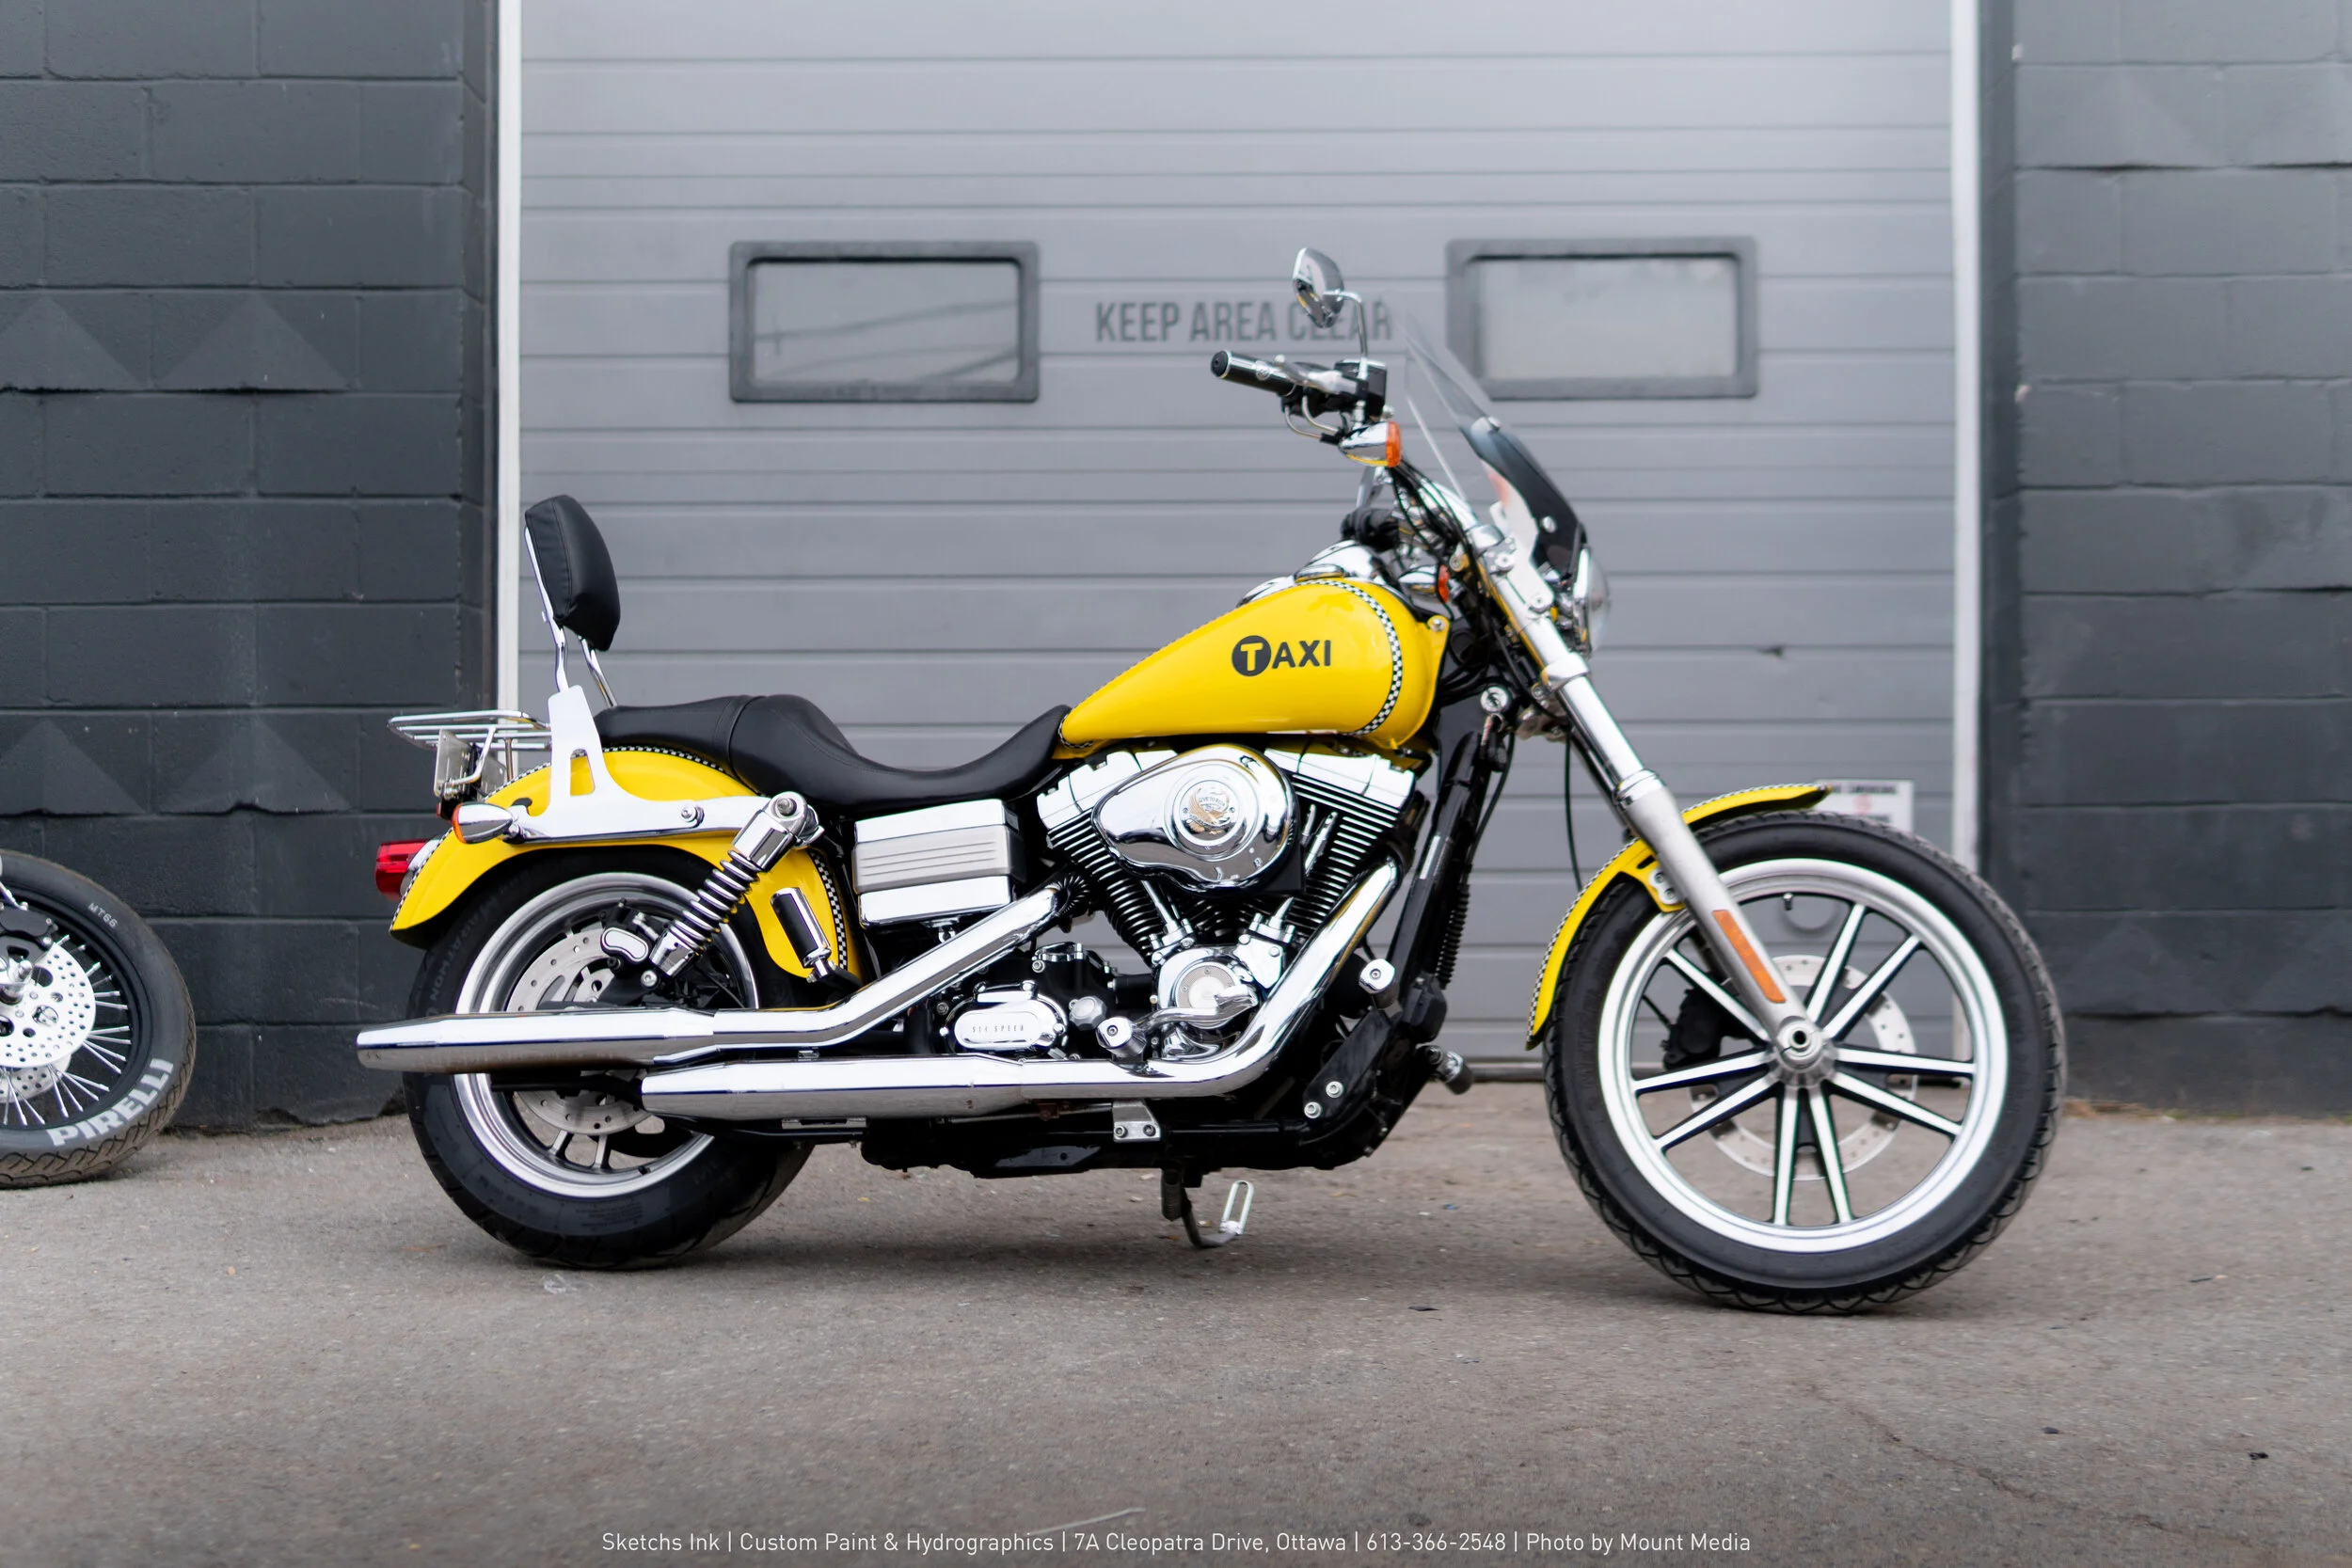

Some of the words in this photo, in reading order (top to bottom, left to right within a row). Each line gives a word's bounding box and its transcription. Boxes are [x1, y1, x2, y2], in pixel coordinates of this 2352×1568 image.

[1096, 302, 1180, 342] KEEP
[1189, 302, 1278, 342] AREA
[1235, 638, 1331, 674] TAXI
[87, 902, 119, 929] MT66
[46, 1058, 173, 1146] PIRELLI
